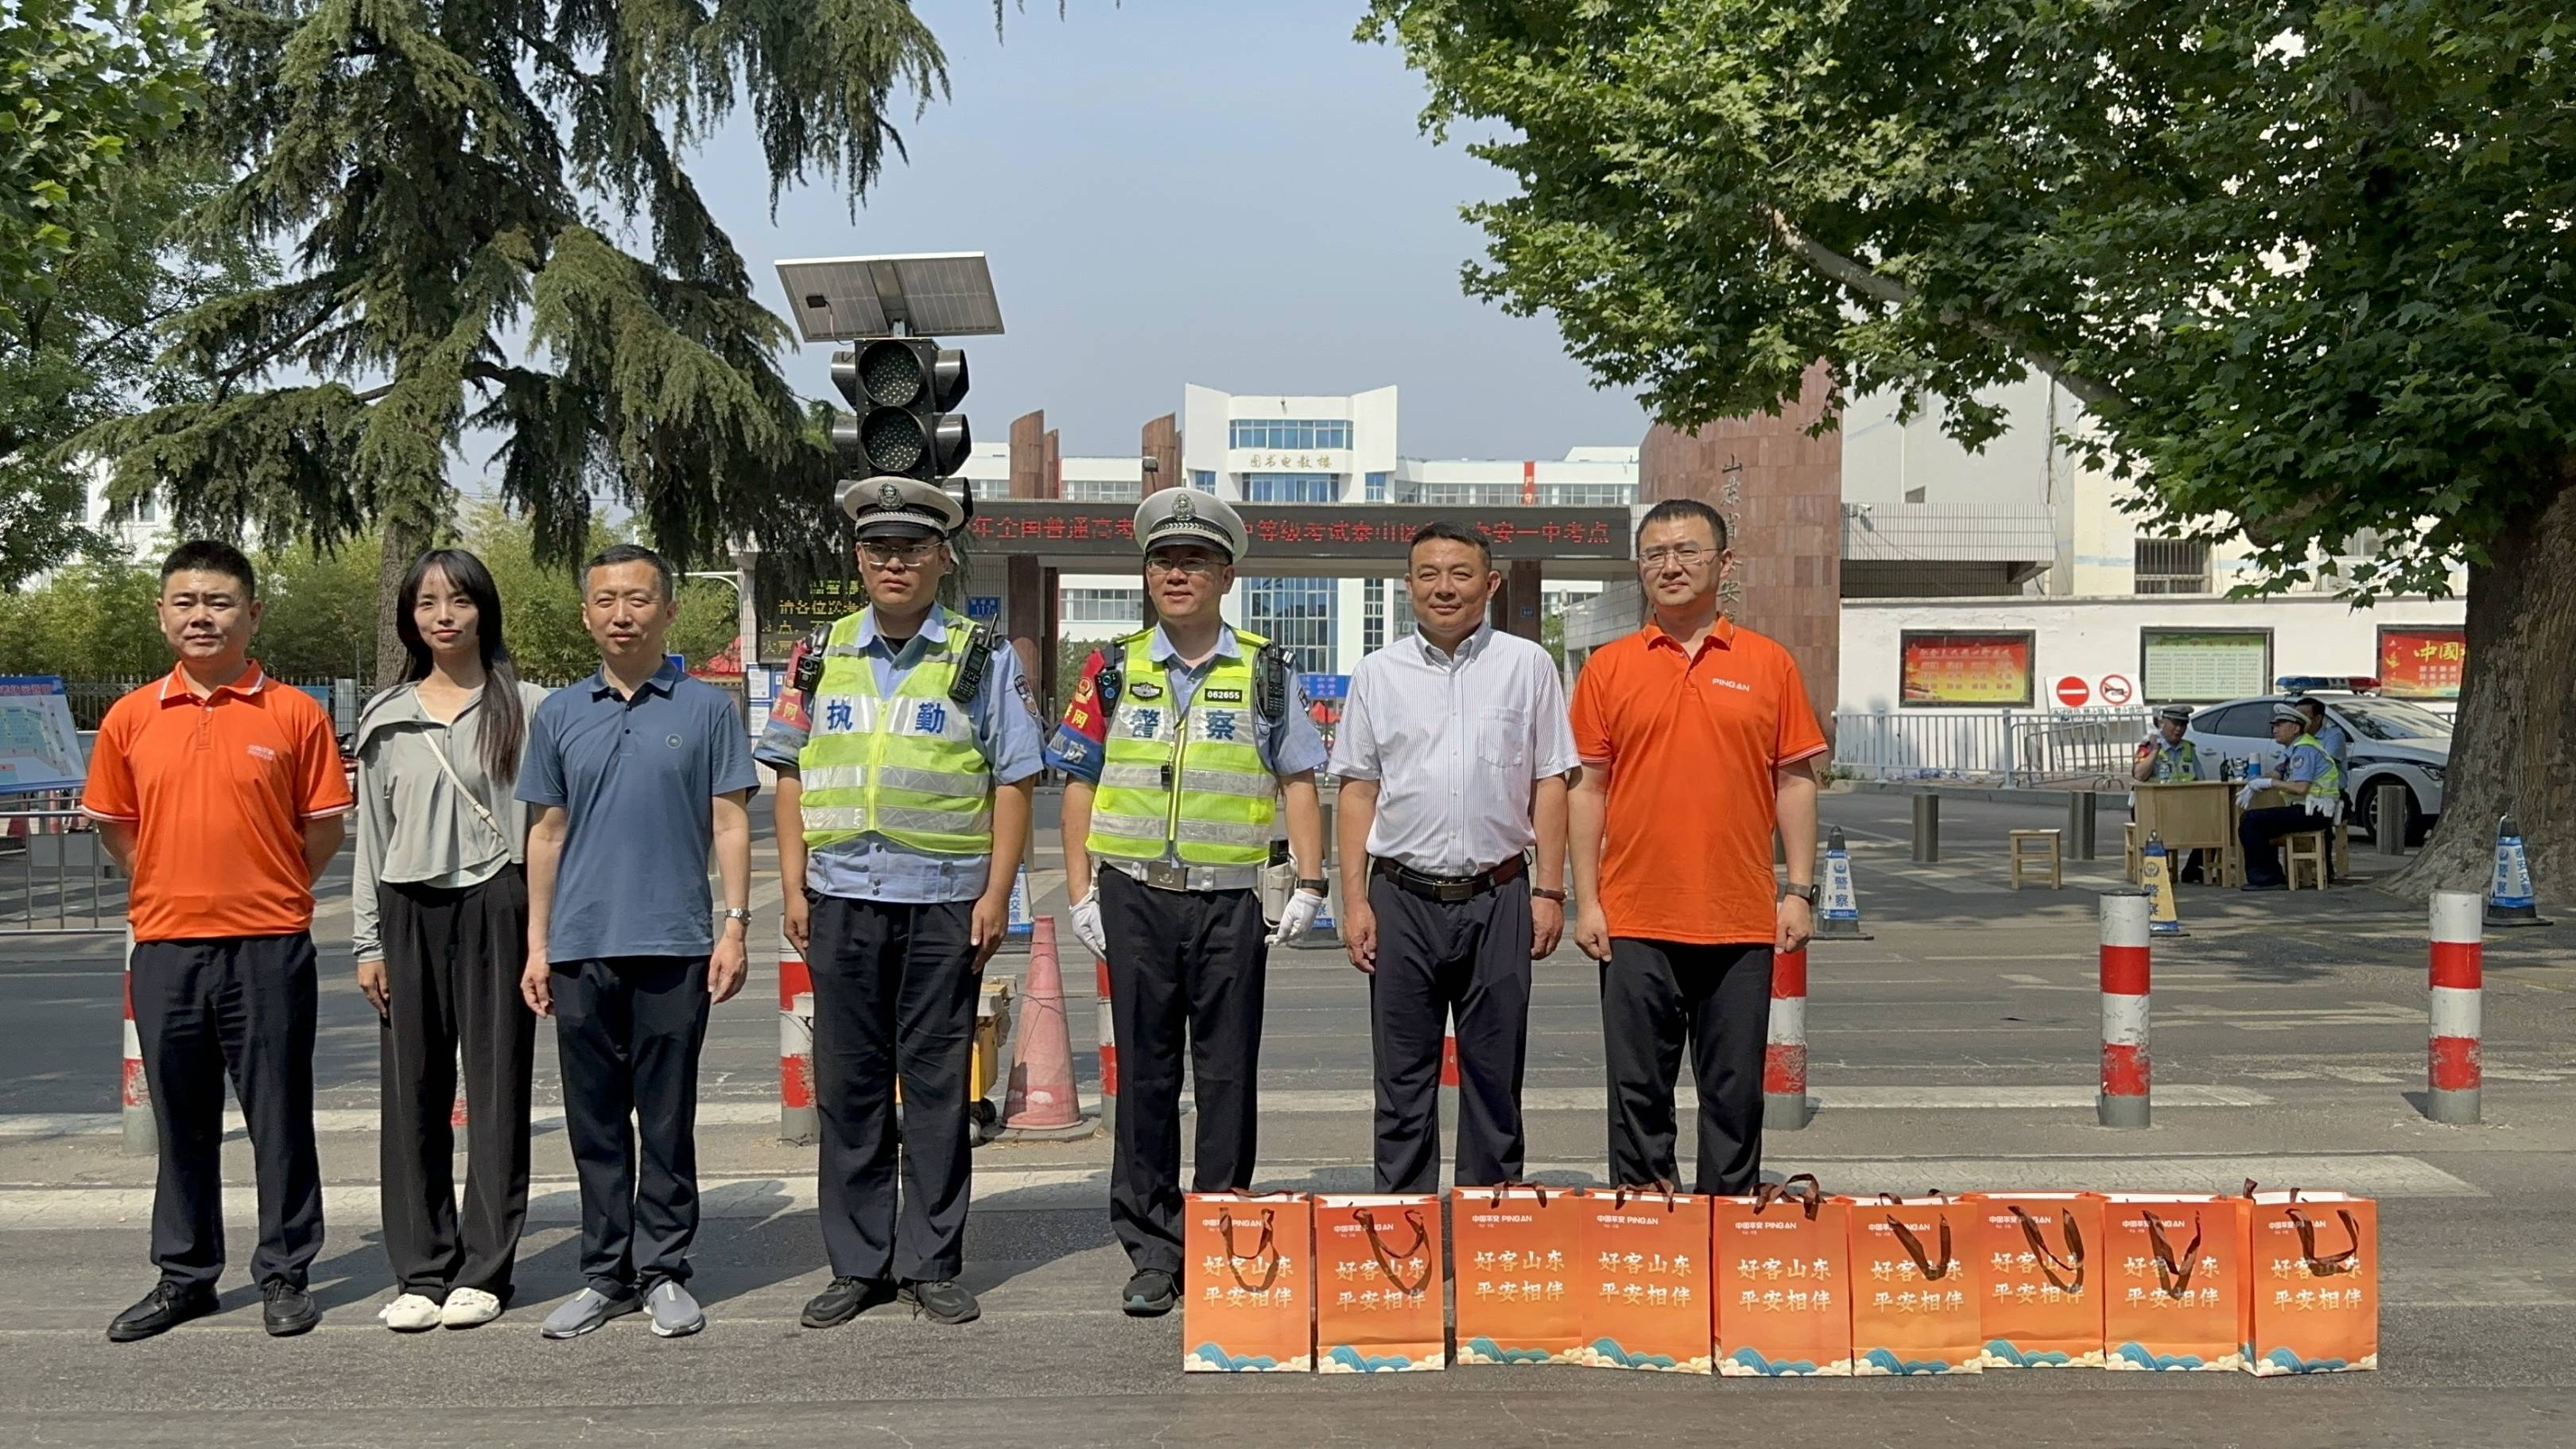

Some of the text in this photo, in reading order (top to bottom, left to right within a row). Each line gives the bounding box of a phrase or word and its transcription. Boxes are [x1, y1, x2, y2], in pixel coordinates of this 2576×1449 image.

[2413, 640, 2465, 662] 中國
[1207, 690, 1240, 700] 062655
[1201, 1254, 1294, 1279] 好客山东
[1334, 1257, 1426, 1282] 好客山东
[1473, 1249, 1565, 1273] 好客山东
[1597, 1251, 1693, 1277] 好客山东
[1737, 1257, 1832, 1282] 好客山东
[1870, 1258, 1965, 1283] 好客东
[2123, 1255, 2221, 1278] 好客东
[1201, 1284, 1294, 1309] 平安相伴
[1335, 1289, 1427, 1312] 平安相伴
[1474, 1280, 1565, 1303] 平安相伴
[1598, 1281, 1693, 1308] 平安相伴
[1738, 1288, 1832, 1312] 平安相伴
[1872, 1290, 1964, 1314] 平安相伴
[1992, 1282, 2085, 1306] 平安相伴
[2125, 1286, 2221, 1310] 平安相伴
[2272, 1287, 2363, 1311] 平安相伴
